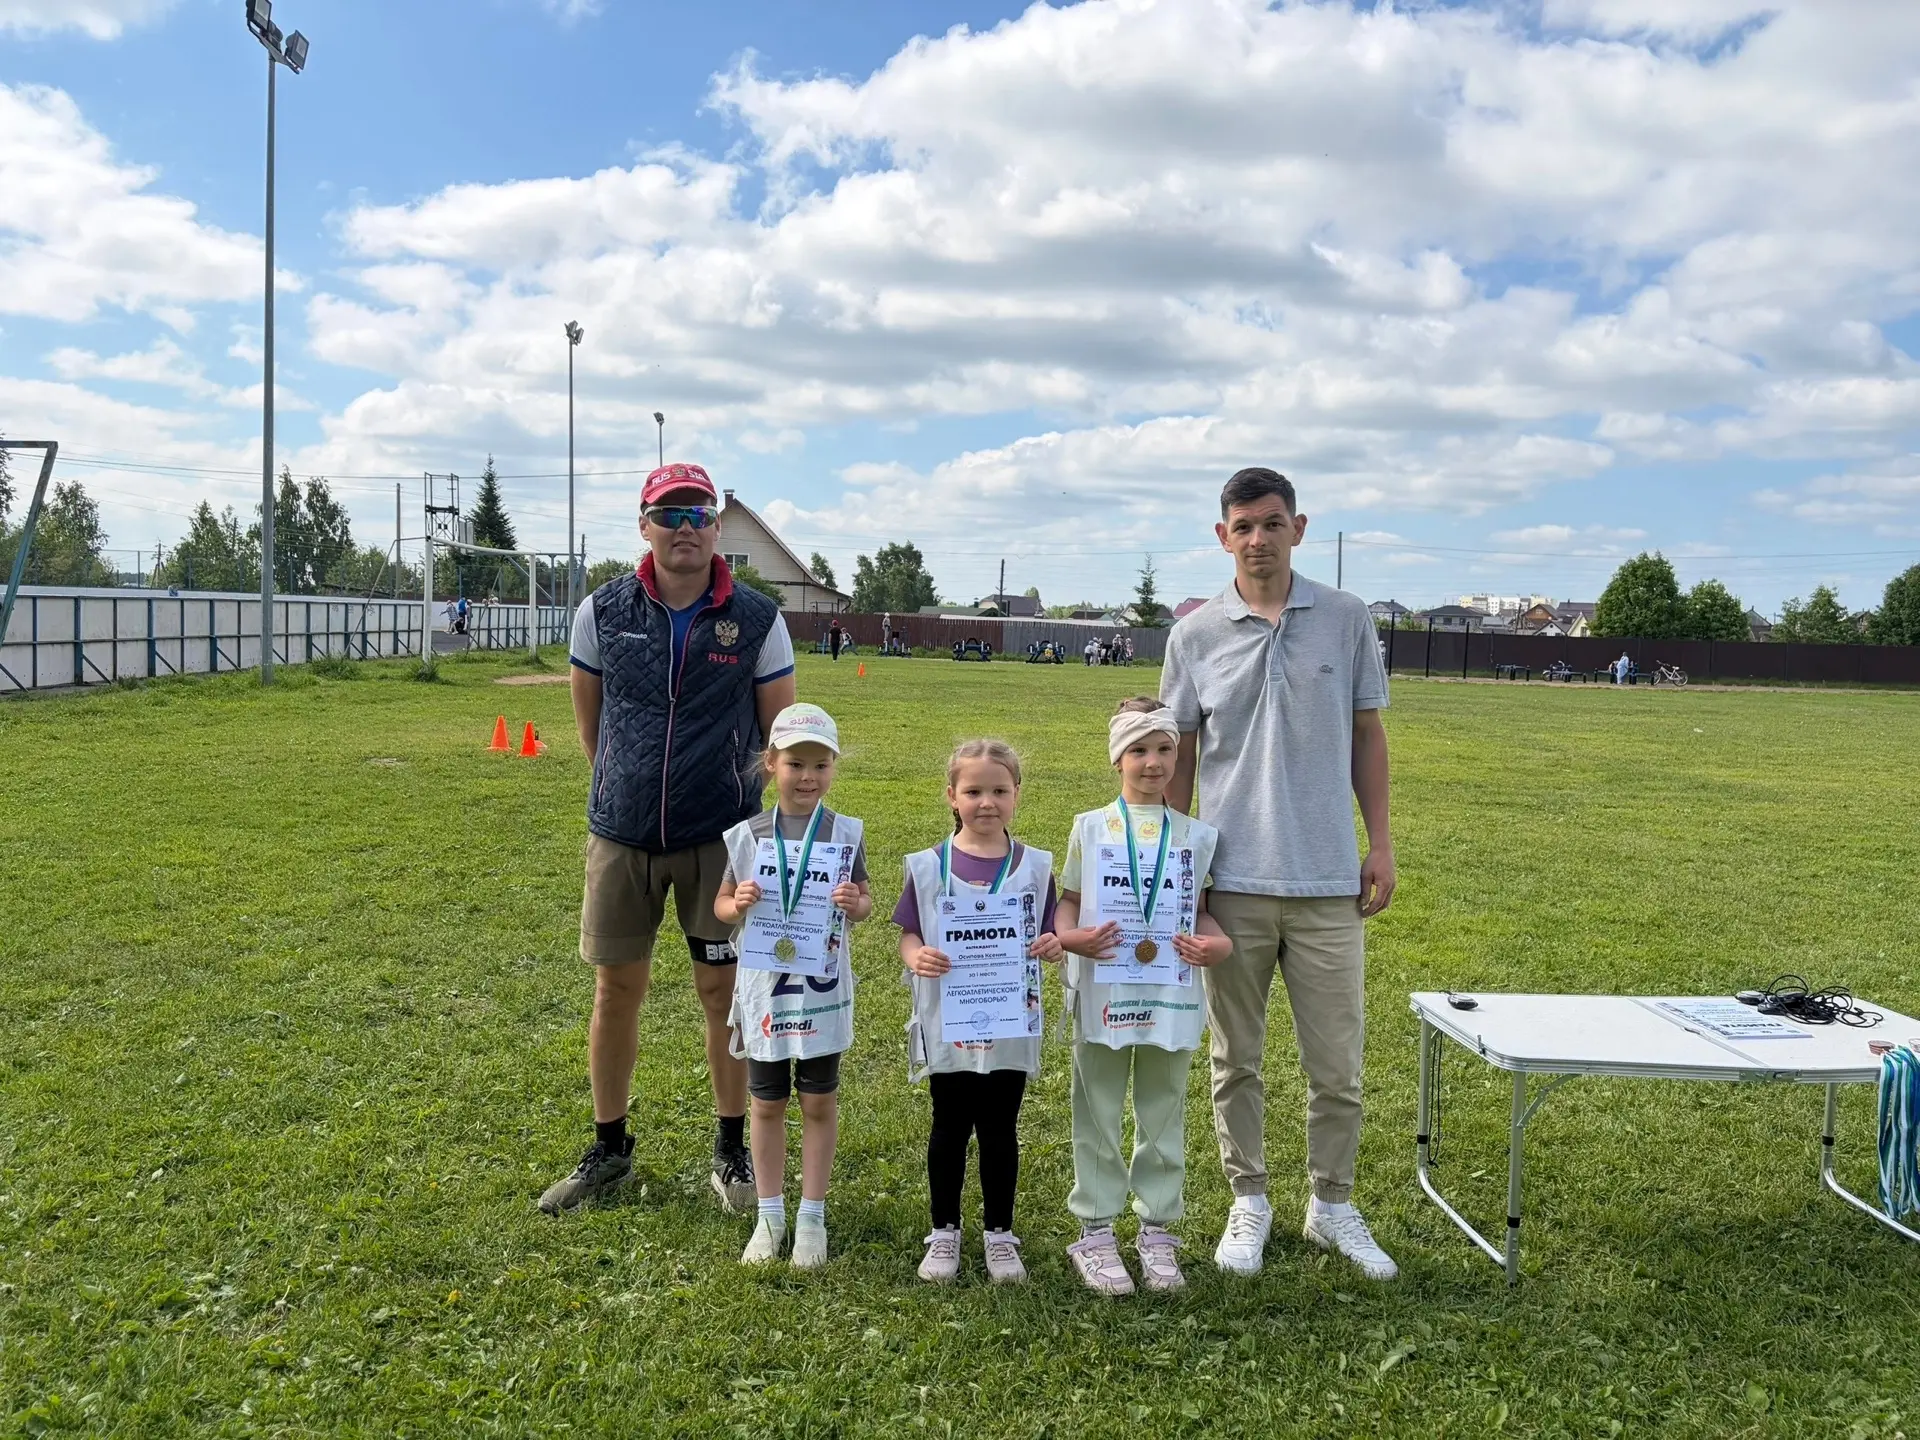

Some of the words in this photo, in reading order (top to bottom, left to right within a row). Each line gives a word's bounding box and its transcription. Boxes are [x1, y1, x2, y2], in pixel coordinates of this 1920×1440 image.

[652, 471, 671, 485] RUS
[708, 652, 738, 664] RUS
[946, 927, 1017, 942] ГРАМОТА
[946, 986, 1020, 998] ЛЕГКОАТЛЕТИЧЕСКОМУ
[959, 996, 1008, 1005] МНОГОБОРЬЮ
[1107, 1010, 1152, 1022] mondi
[771, 1019, 813, 1032] mondi
